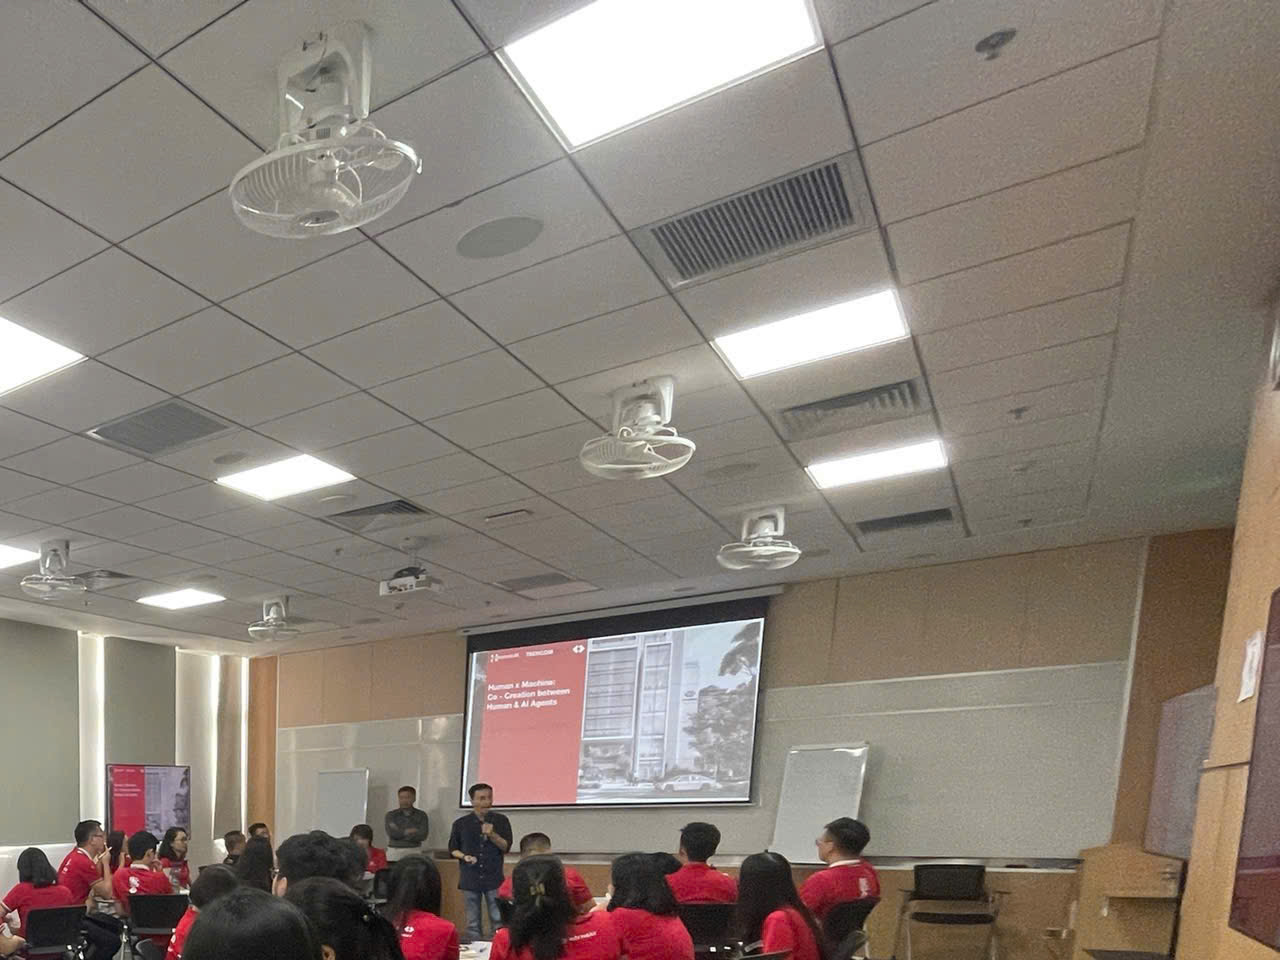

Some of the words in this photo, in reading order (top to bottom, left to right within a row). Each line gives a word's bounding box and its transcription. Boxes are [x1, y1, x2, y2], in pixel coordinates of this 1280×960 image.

[487, 683, 514, 691] Human
[487, 693, 498, 701] Co
[504, 690, 536, 700] Creation
[537, 688, 571, 697] between
[486, 702, 513, 710] Human
[513, 700, 520, 708] &
[521, 700, 529, 708] AI
[530, 699, 558, 709] Agents
